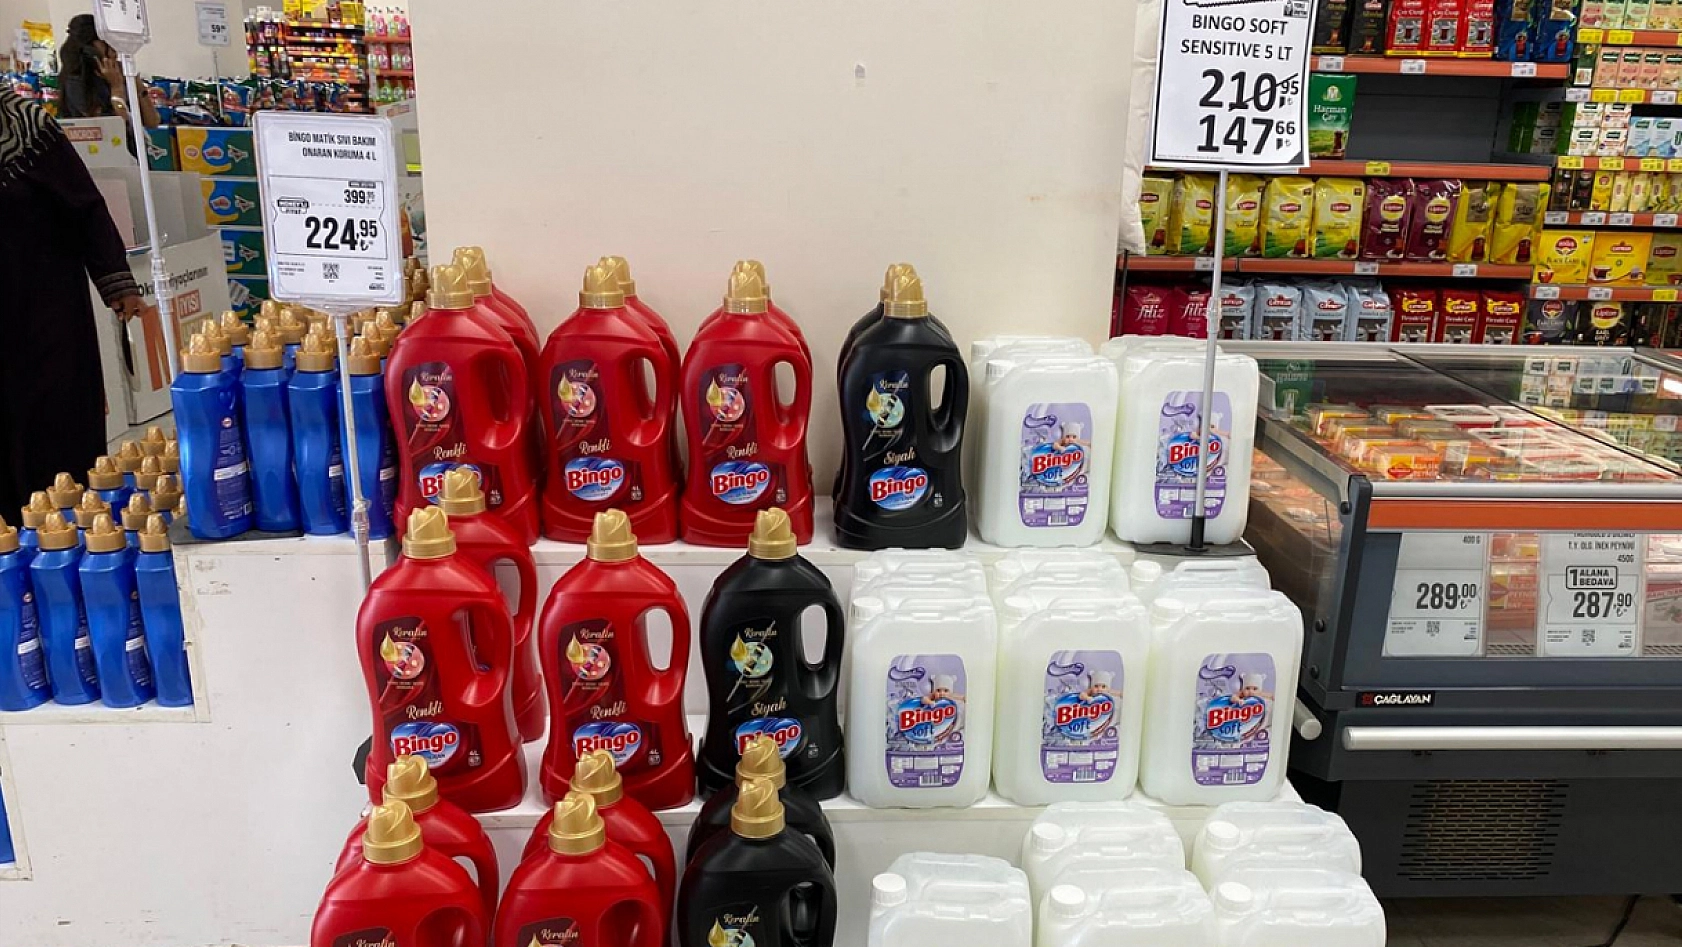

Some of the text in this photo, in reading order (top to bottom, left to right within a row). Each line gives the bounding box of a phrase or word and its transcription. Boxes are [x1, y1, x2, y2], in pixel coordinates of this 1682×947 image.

[1192, 14, 1288, 35] BINGO SOFT
[1180, 39, 1293, 61] SENSITIVE 5 LT
[288, 131, 312, 143] BİNGO
[312, 132, 335, 144] MATİK
[352, 135, 376, 146] BAKIM
[302, 147, 377, 161] ONARAN KORUMA 4 L
[1137, 304, 1165, 320] filiz
[433, 442, 467, 460] Renkli
[579, 438, 611, 455] Renkli
[726, 441, 757, 459] Renkli
[883, 447, 916, 466] Siyah
[1169, 441, 1220, 464] Bino
[1032, 449, 1083, 474] Bingo
[567, 466, 622, 490] Bingo
[713, 469, 768, 495] Bingo
[871, 473, 928, 502] Bingo
[1570, 569, 1578, 586] 1
[1580, 569, 1609, 578] ALANA
[1580, 577, 1614, 586] BEDAVA
[751, 697, 787, 717] Siyah
[1374, 692, 1432, 706] ÇAĞLAYAN
[405, 700, 444, 720] Renkli
[590, 700, 627, 720] Renkli
[899, 705, 956, 731] Bingo
[1057, 700, 1112, 724] Bingo
[1207, 702, 1263, 728] Bingo
[394, 731, 457, 758] Bingo
[540, 928, 579, 942] Keratin
